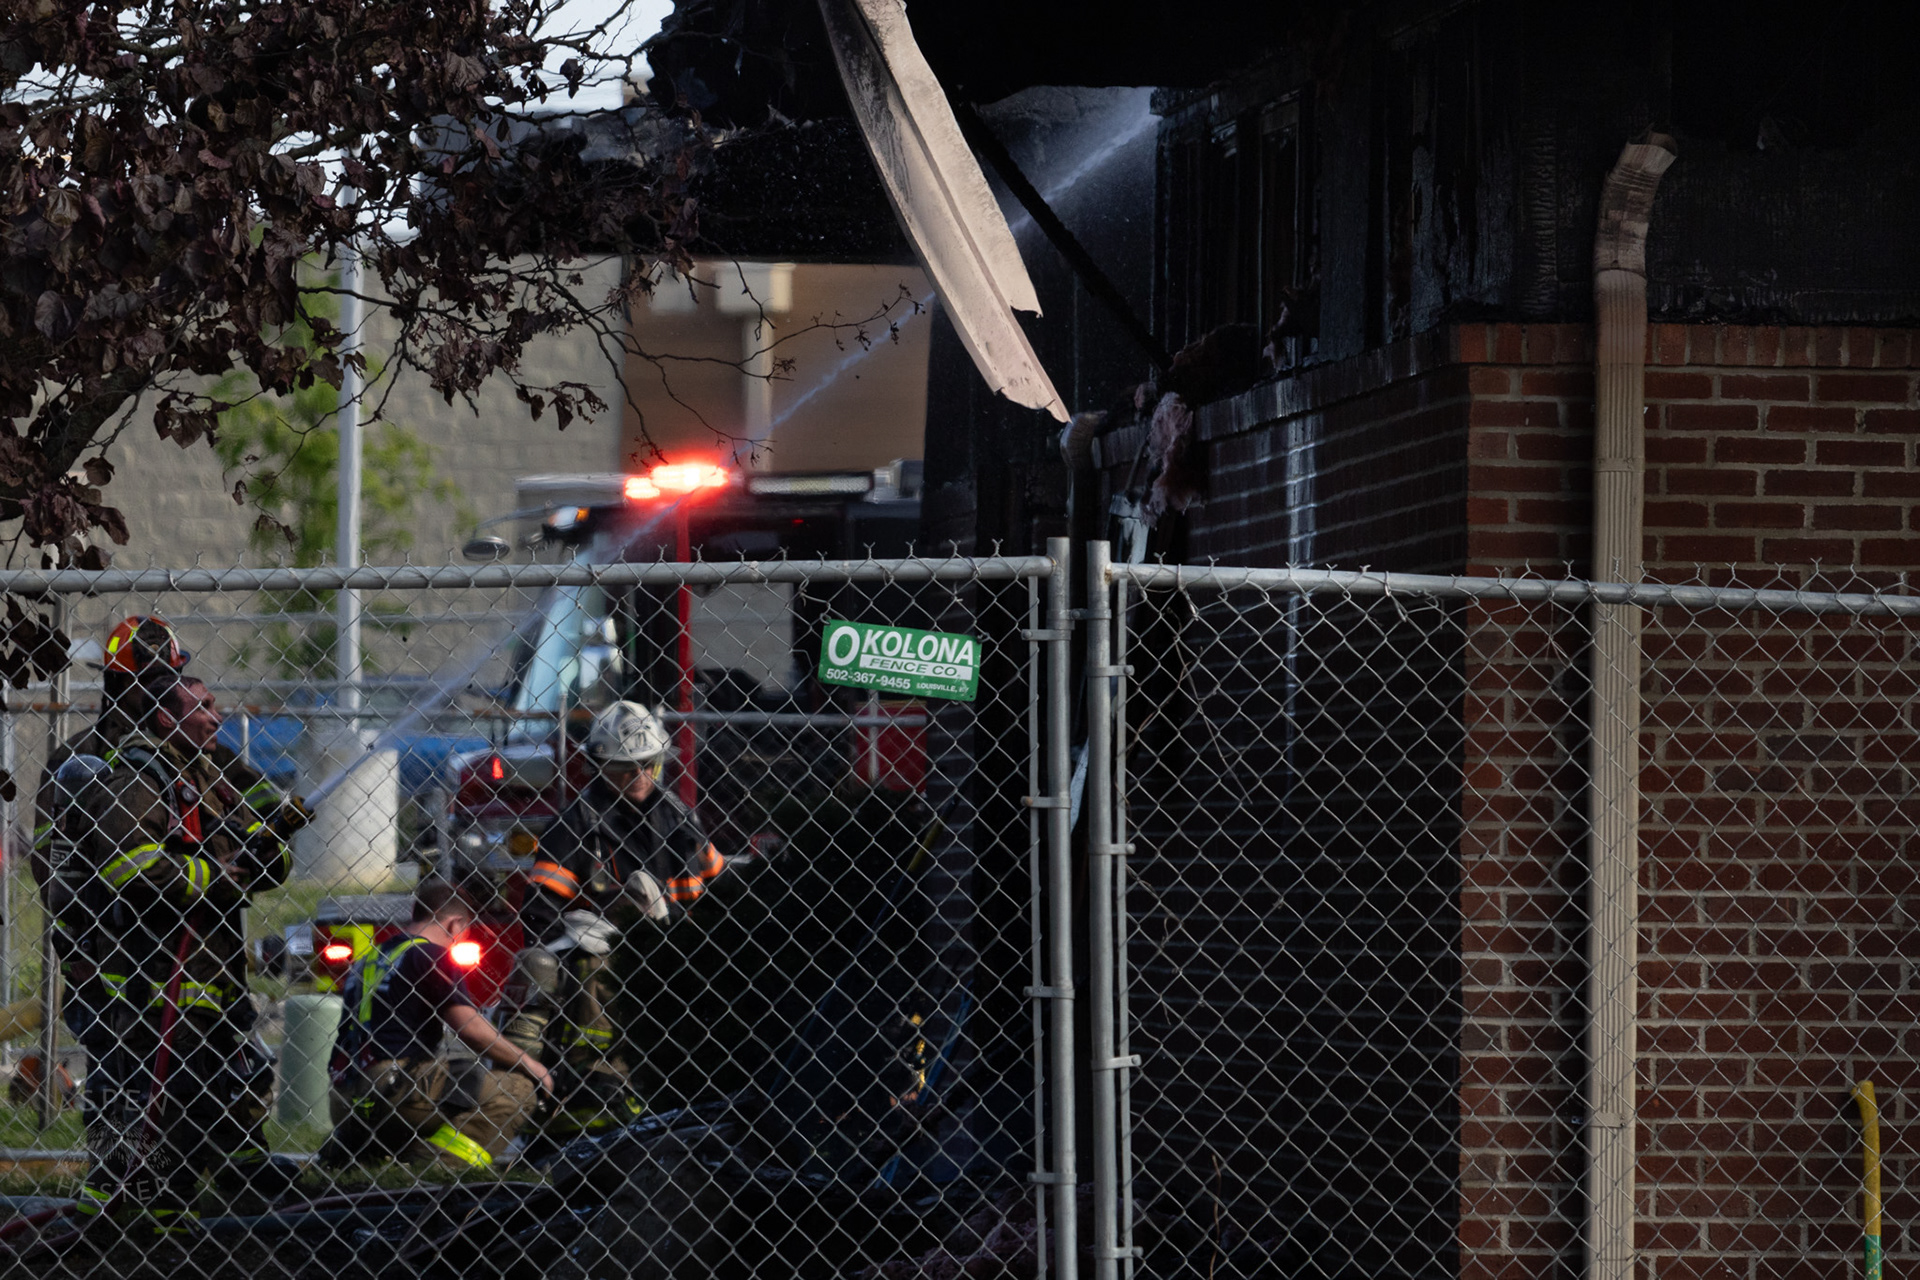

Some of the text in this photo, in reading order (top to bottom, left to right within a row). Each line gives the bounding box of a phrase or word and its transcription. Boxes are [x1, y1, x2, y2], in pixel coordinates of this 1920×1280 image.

[828, 626, 974, 666] OKOLONA
[825, 668, 911, 690] 502-367-9455
[869, 658, 961, 678] FENCE CO.
